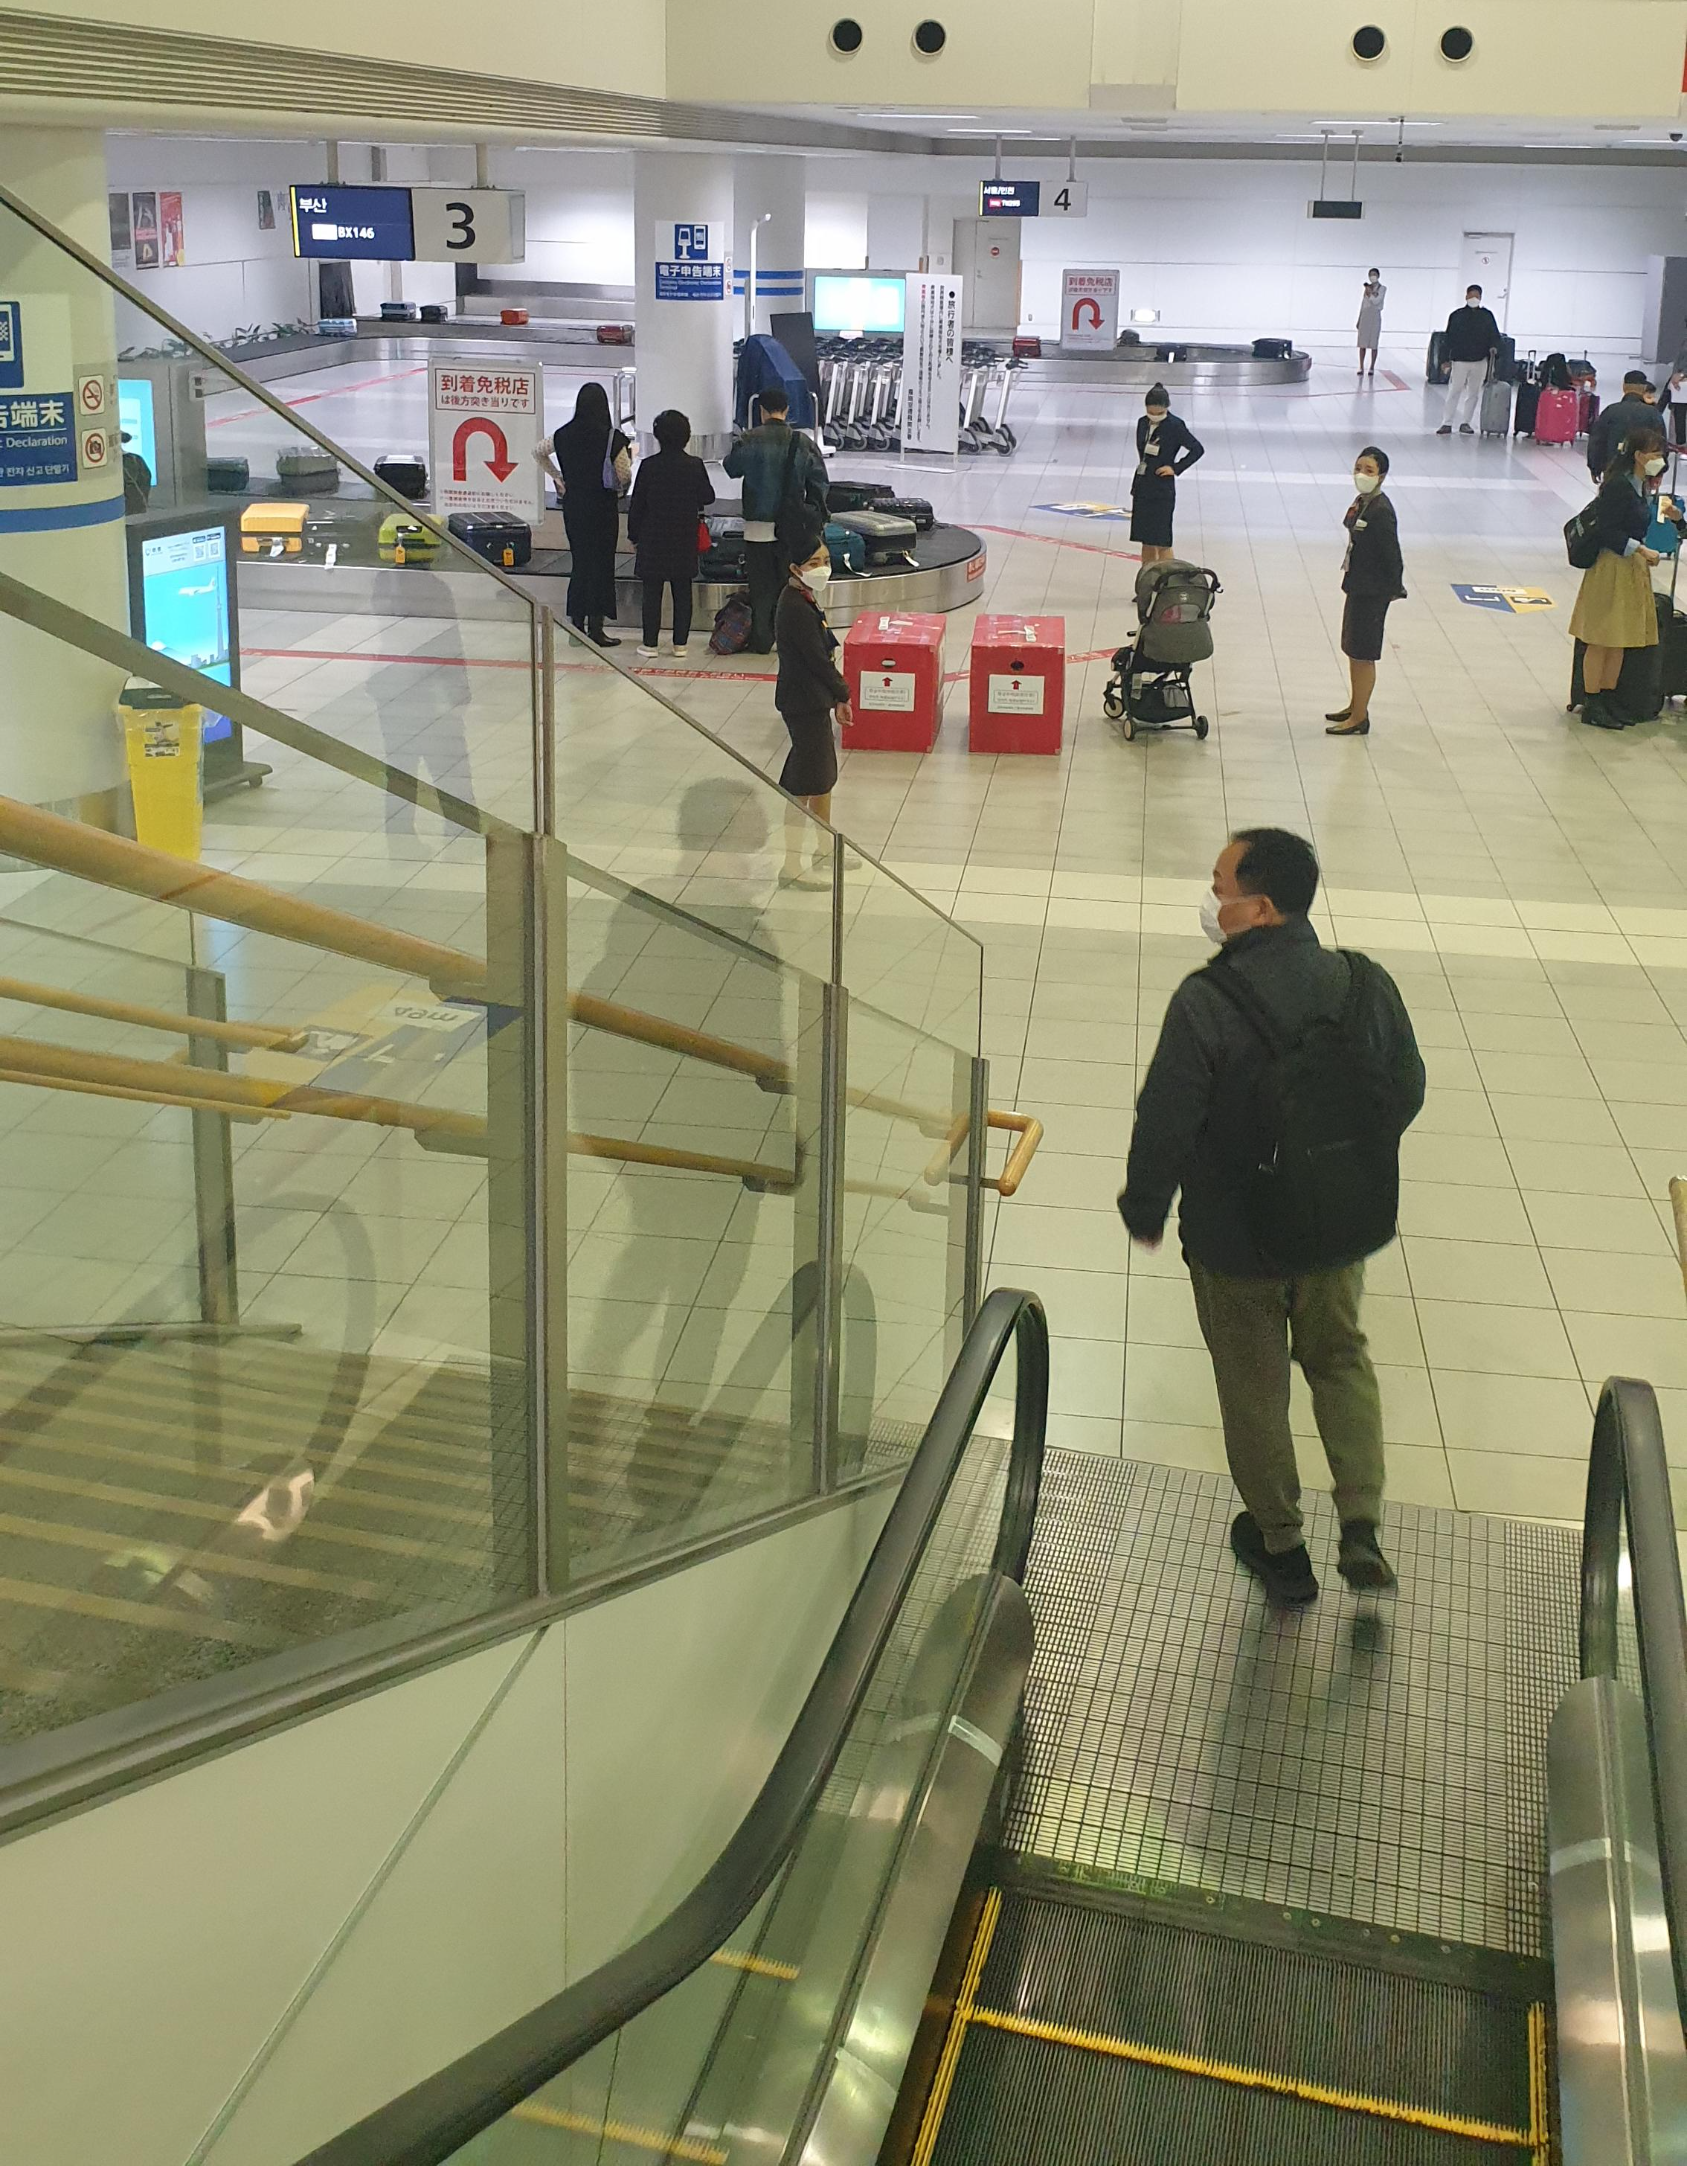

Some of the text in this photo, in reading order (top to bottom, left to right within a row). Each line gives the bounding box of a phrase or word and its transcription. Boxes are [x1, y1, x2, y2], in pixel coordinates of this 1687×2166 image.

[299, 198, 328, 213] 부산
[1053, 188, 1072, 211] 4
[337, 226, 375, 239] BX146
[445, 202, 476, 250] 3
[440, 374, 530, 396] 到着免税店
[440, 395, 531, 410] は後方突き当りです
[6, 436, 68, 449] Declaration
